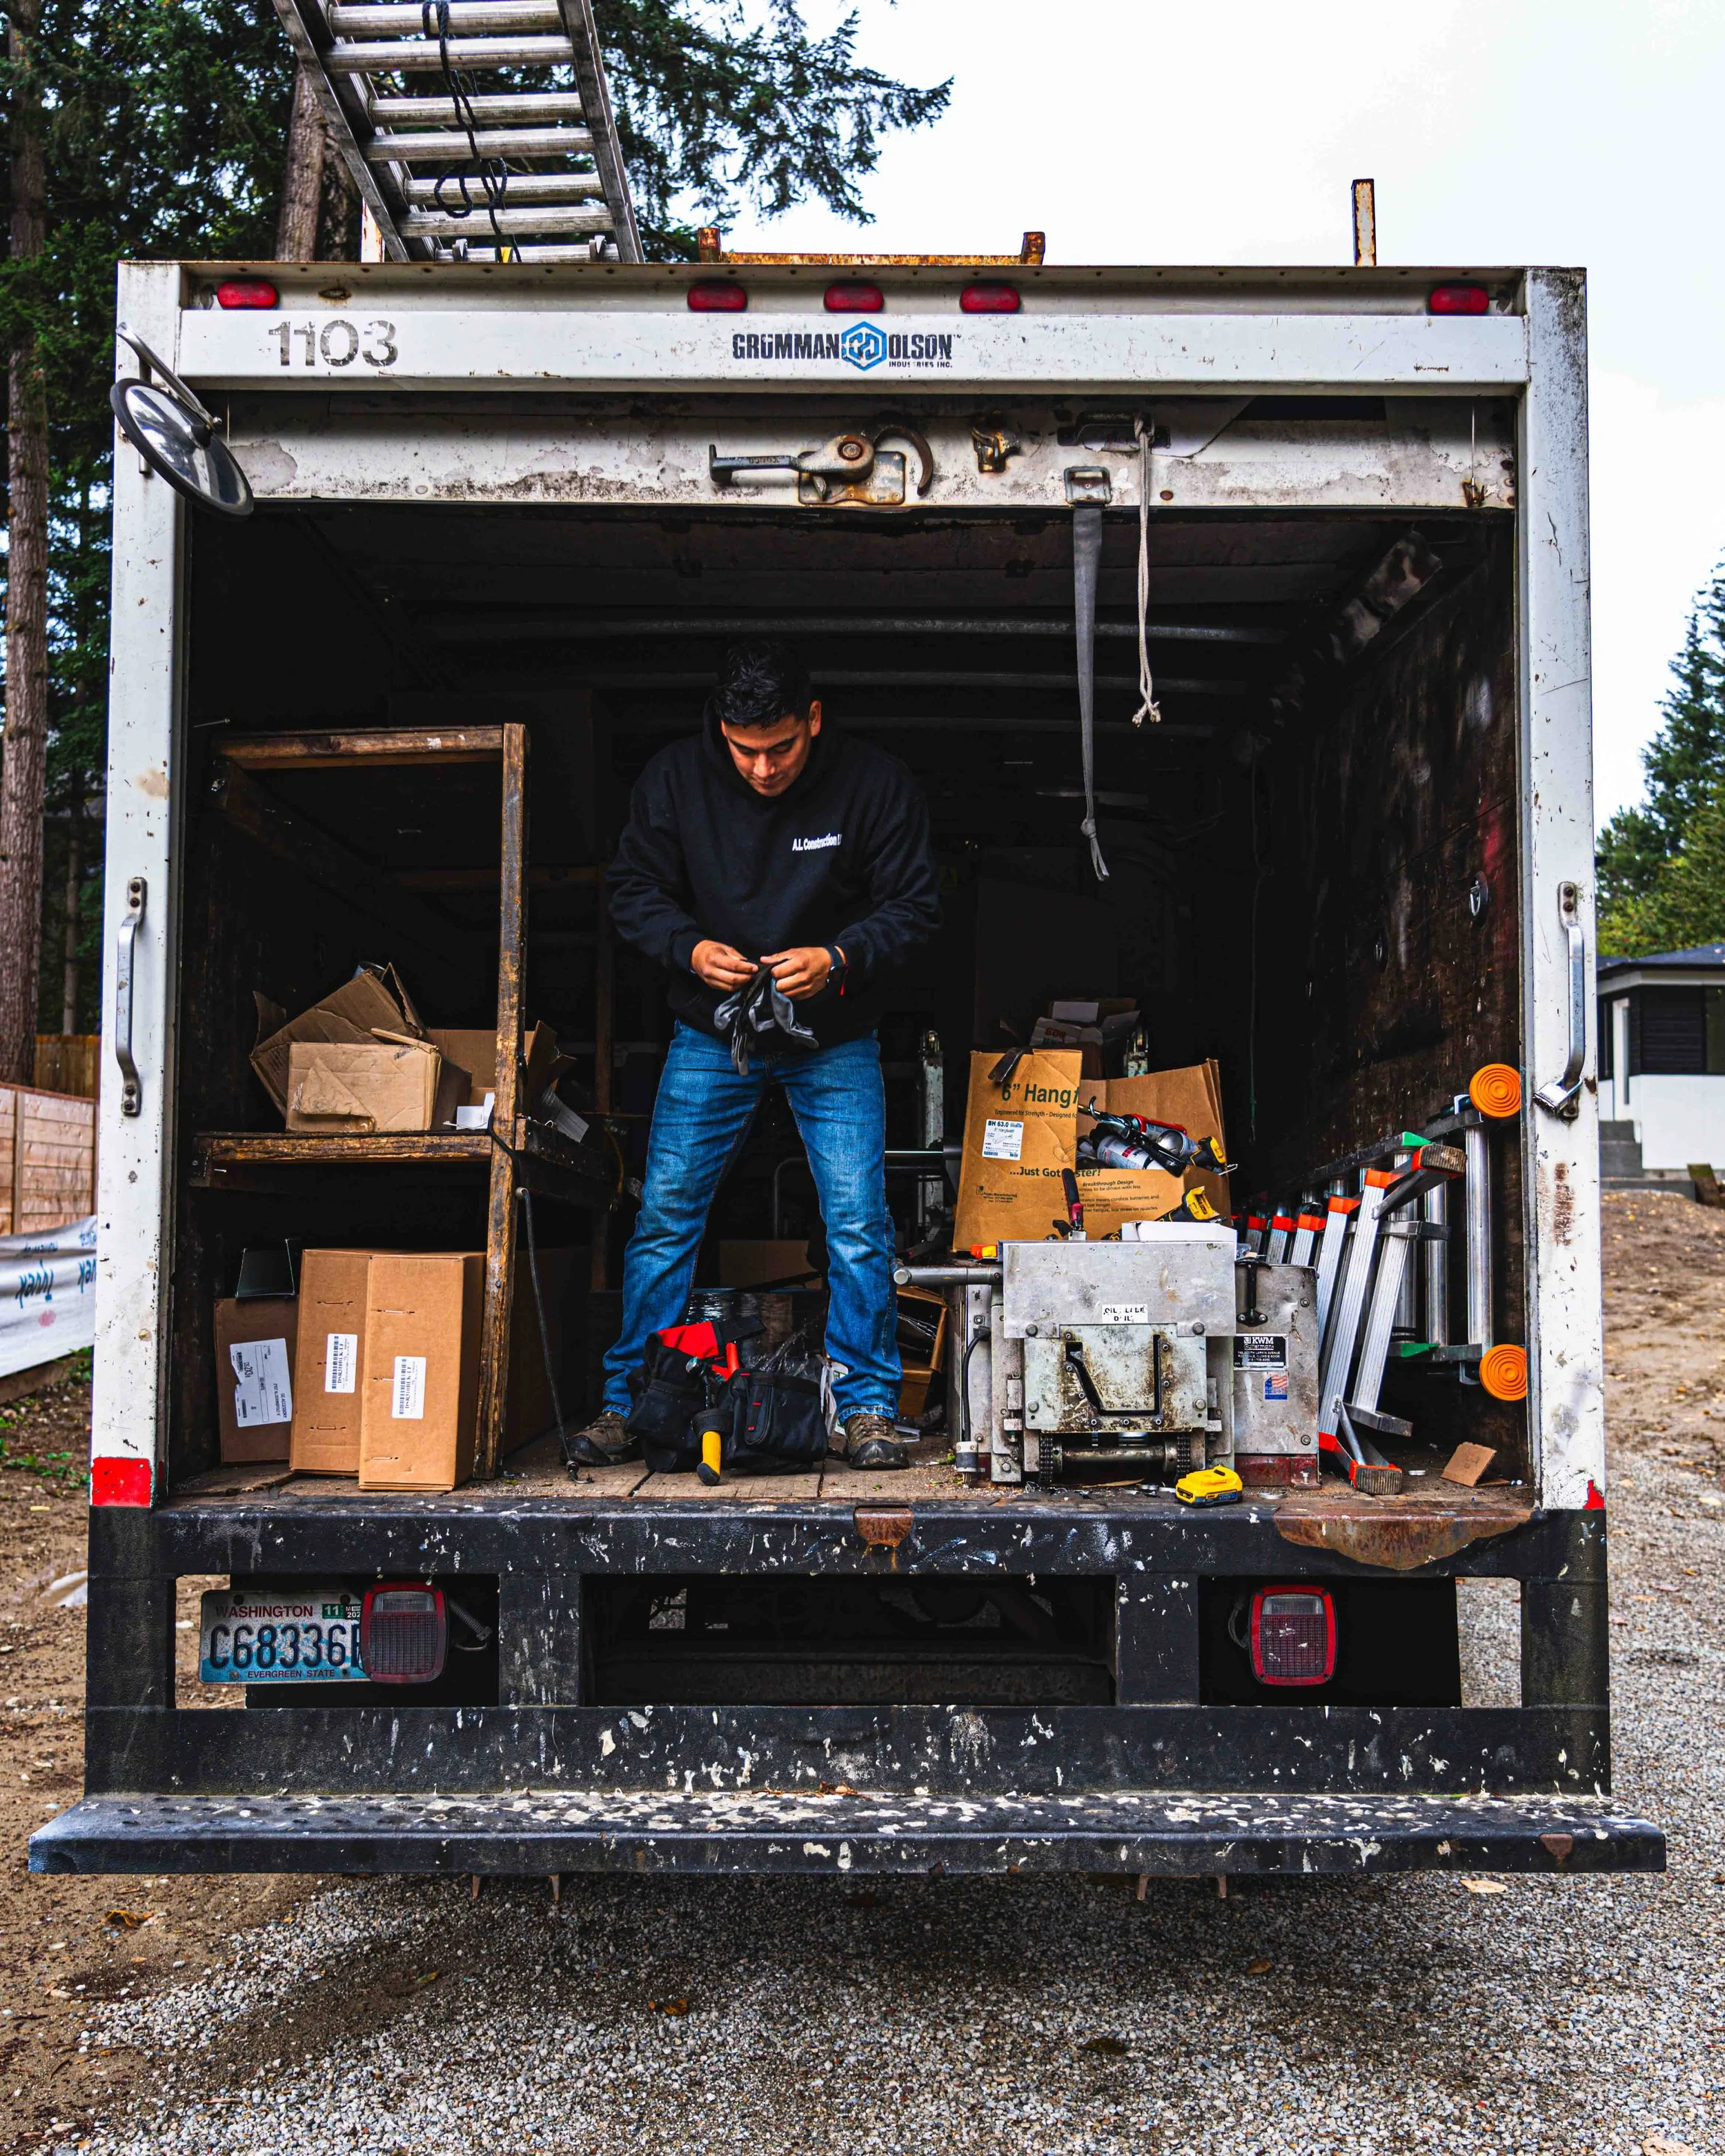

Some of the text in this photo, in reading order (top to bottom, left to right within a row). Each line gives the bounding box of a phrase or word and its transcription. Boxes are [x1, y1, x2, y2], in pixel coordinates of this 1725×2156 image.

[268, 319, 398, 366] 1103
[733, 334, 952, 359] GRUMMAN OLSON
[804, 833, 837, 850] Construction
[1043, 1168, 1061, 1177] Got
[1076, 1169, 1101, 1178] ster!
[215, 1605, 313, 1618] WASHINGTON
[325, 1605, 339, 1616] 11
[248, 1669, 335, 1679] EVERGREEN STATE
